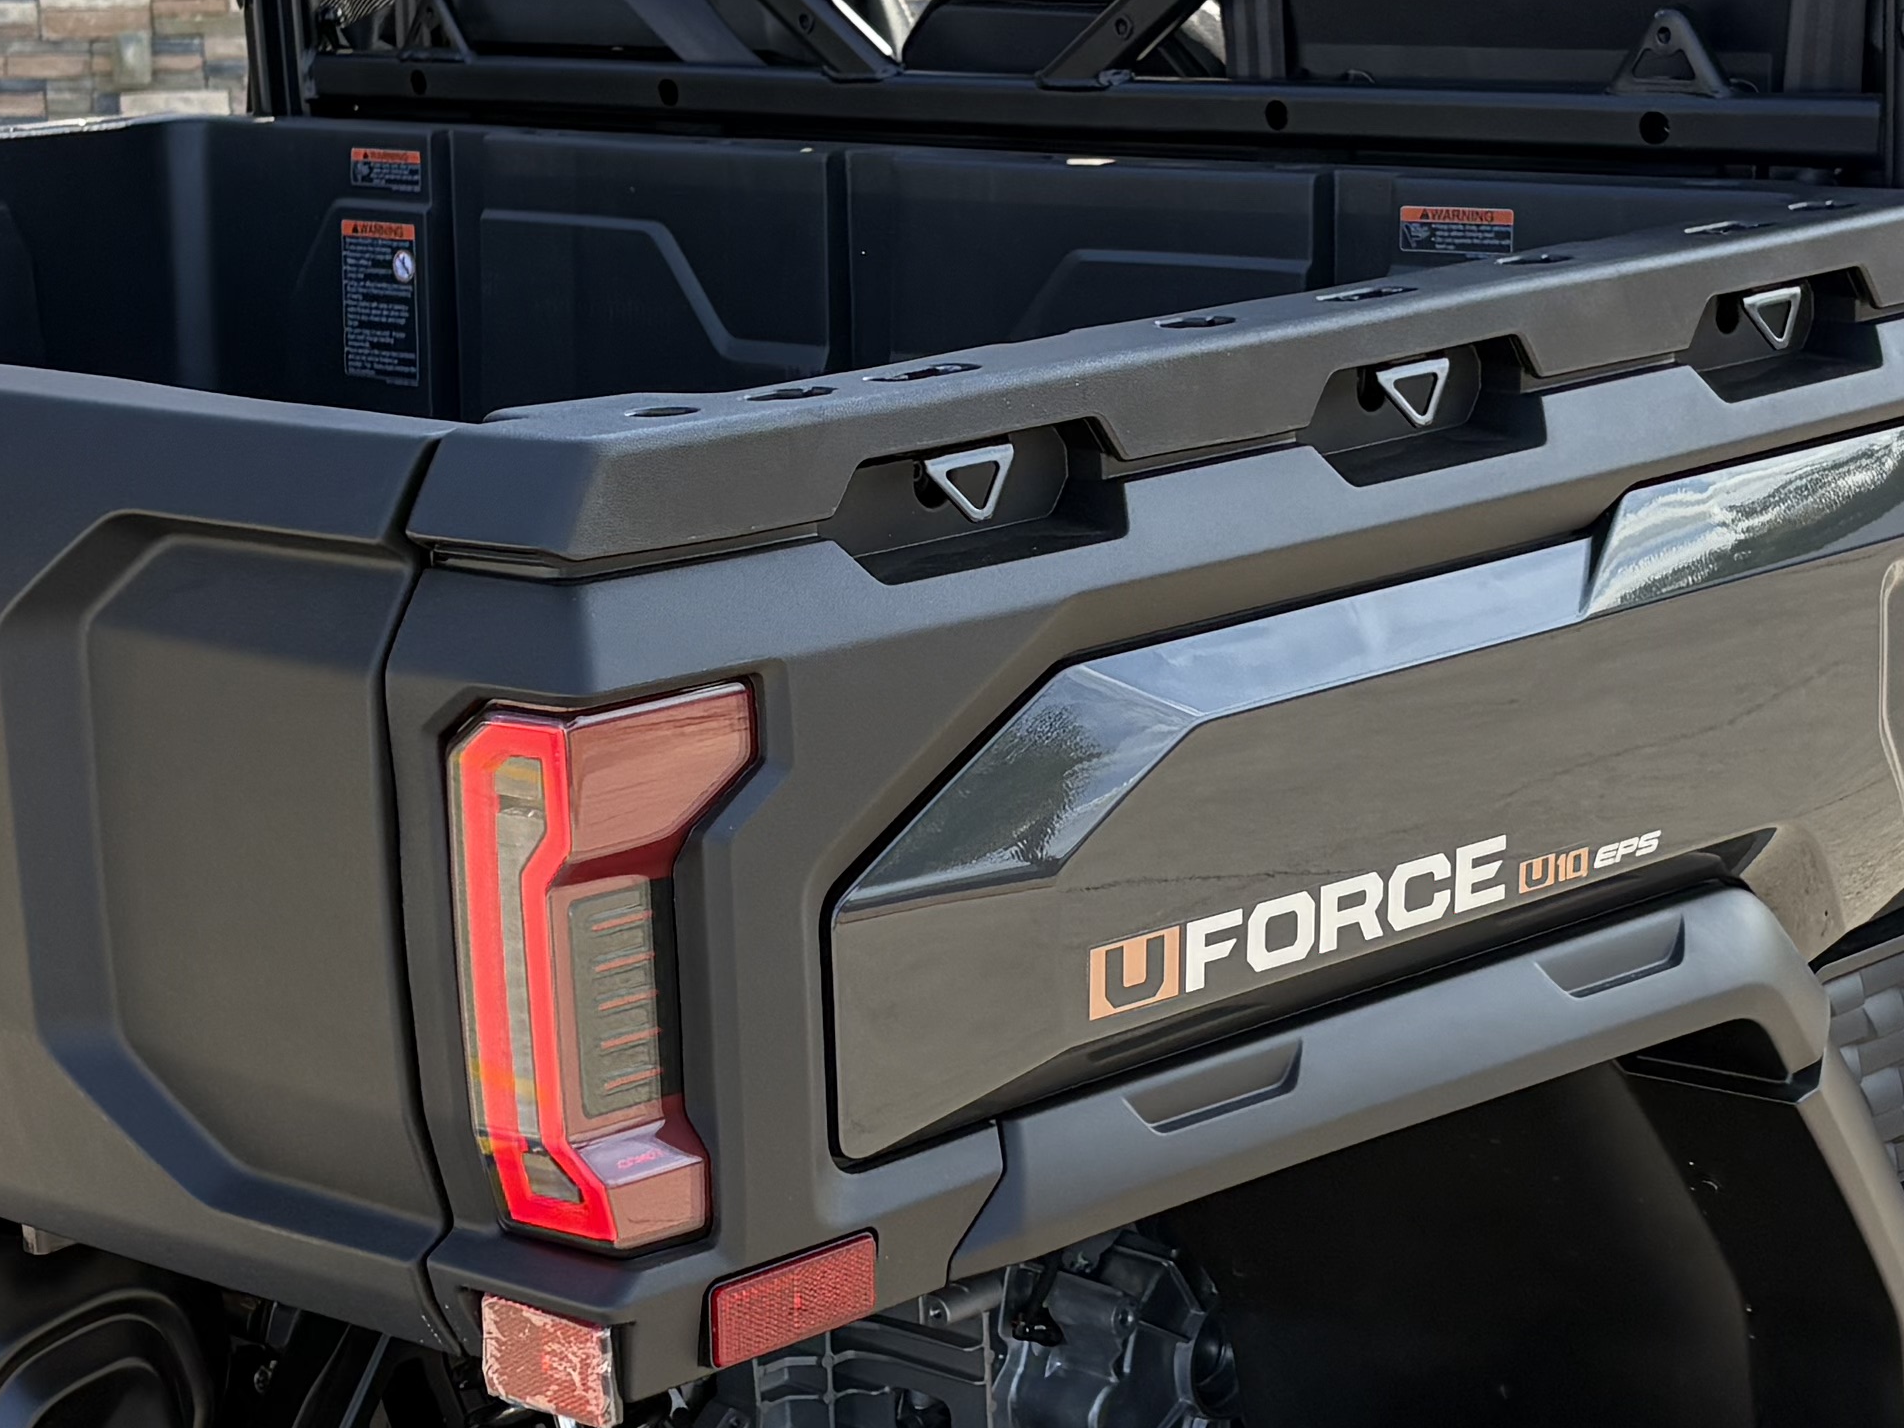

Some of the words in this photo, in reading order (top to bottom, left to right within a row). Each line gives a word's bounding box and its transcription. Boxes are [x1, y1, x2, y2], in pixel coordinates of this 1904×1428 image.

[1430, 209, 1495, 223] WARNING
[1517, 846, 1589, 895] U10
[1592, 829, 1662, 869] EPS
